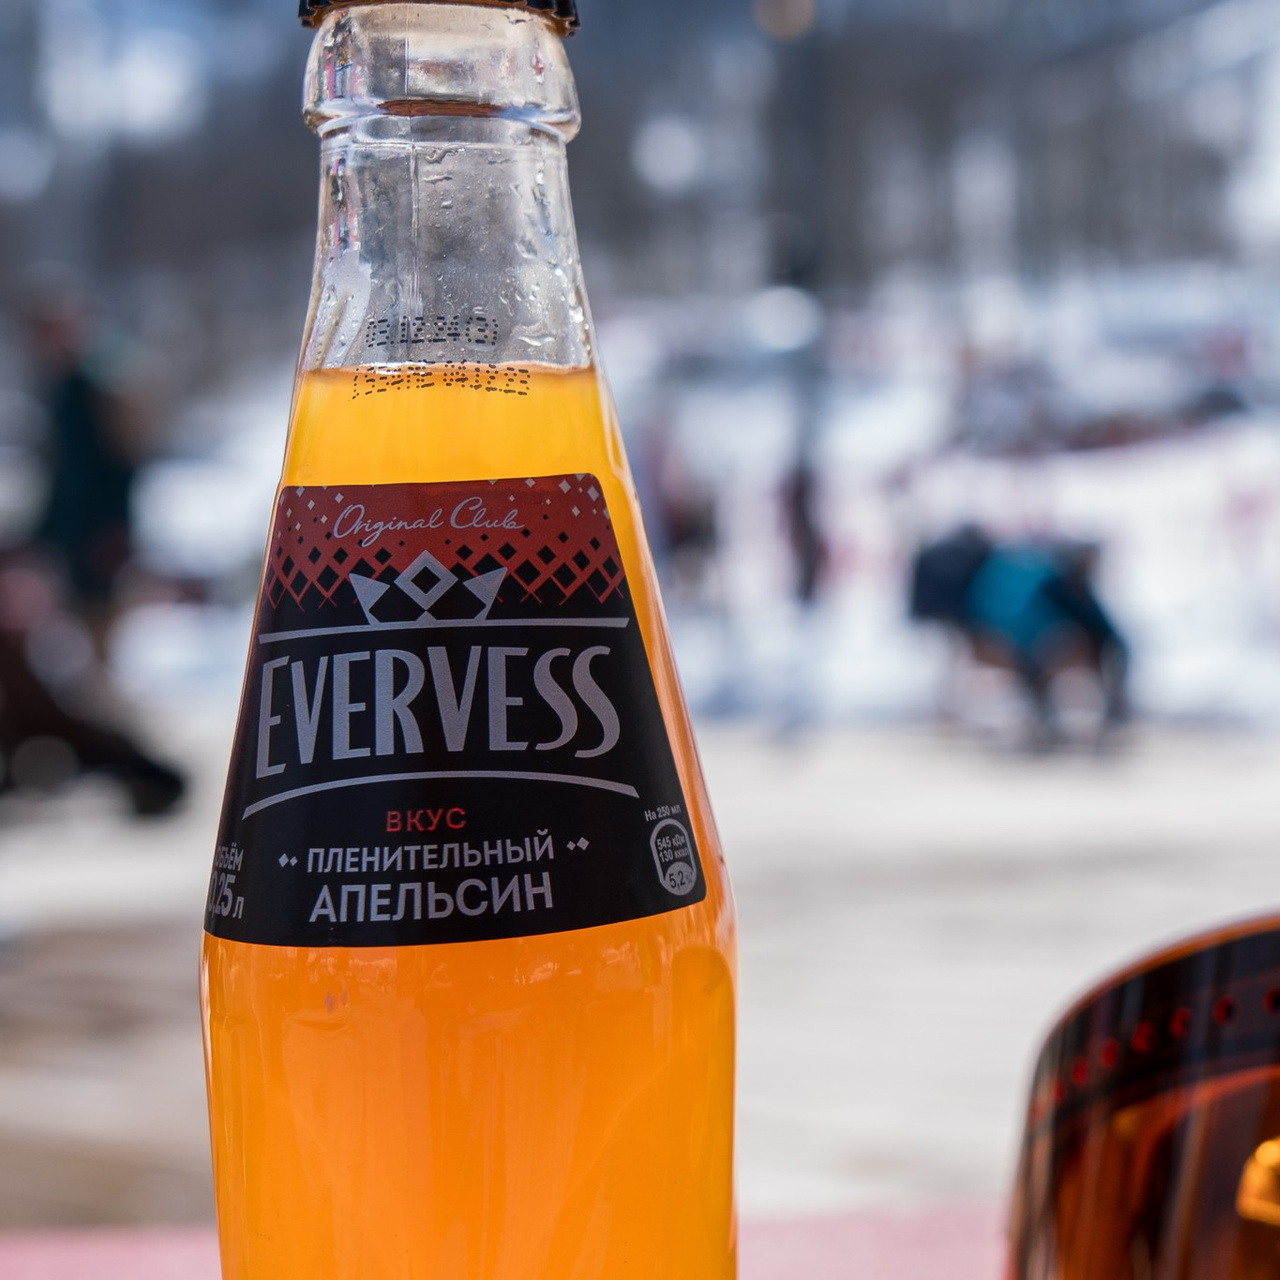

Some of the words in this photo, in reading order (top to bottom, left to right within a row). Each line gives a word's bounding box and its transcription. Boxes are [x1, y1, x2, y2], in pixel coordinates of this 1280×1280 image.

[332, 503, 445, 548] Original
[450, 495, 525, 530] Club
[255, 645, 622, 780] EVERVESS
[385, 806, 467, 833] ВКУС
[656, 804, 671, 819] 250
[306, 827, 555, 874] ПЛЕНИТЕЛЬНЫЙ
[659, 848, 674, 863] 130
[308, 871, 554, 923] АПЕЛЬСИН
